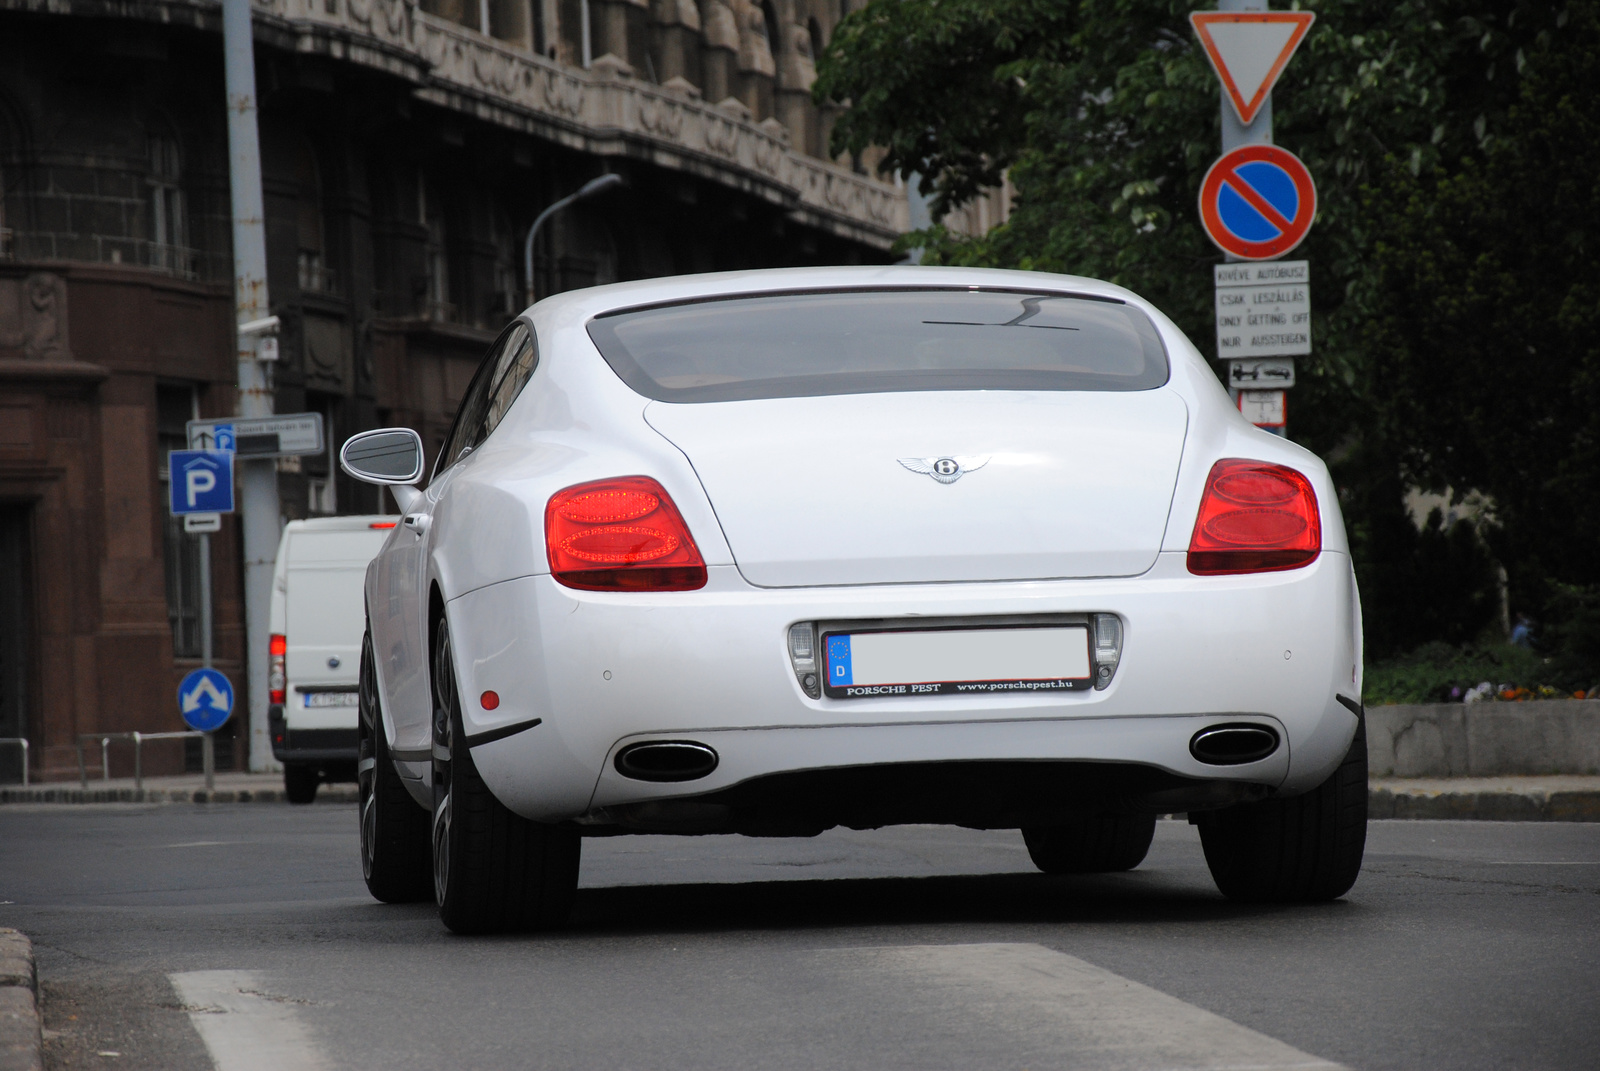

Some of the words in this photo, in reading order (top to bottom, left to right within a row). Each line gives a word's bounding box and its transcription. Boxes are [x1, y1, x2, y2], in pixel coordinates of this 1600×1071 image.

[1218, 266, 1250, 280] KIVÉVE
[1257, 265, 1306, 279] AUTÓBUSZ
[1220, 294, 1246, 305] CSAK
[1252, 288, 1305, 305] LESZÁLLÁS
[1219, 316, 1242, 327] ONLY
[1247, 312, 1287, 326] GETTING
[1291, 312, 1309, 324] OFF
[1221, 336, 1242, 347] NUR
[1251, 333, 1308, 347] AUSSTEIGEN
[219, 434, 231, 450] P
[936, 459, 956, 475] B
[186, 469, 216, 507] P
[836, 665, 846, 677] D
[846, 685, 907, 696] PORSCHE
[911, 683, 941, 693] PEST
[957, 680, 1073, 691] www.porschepest.hu
